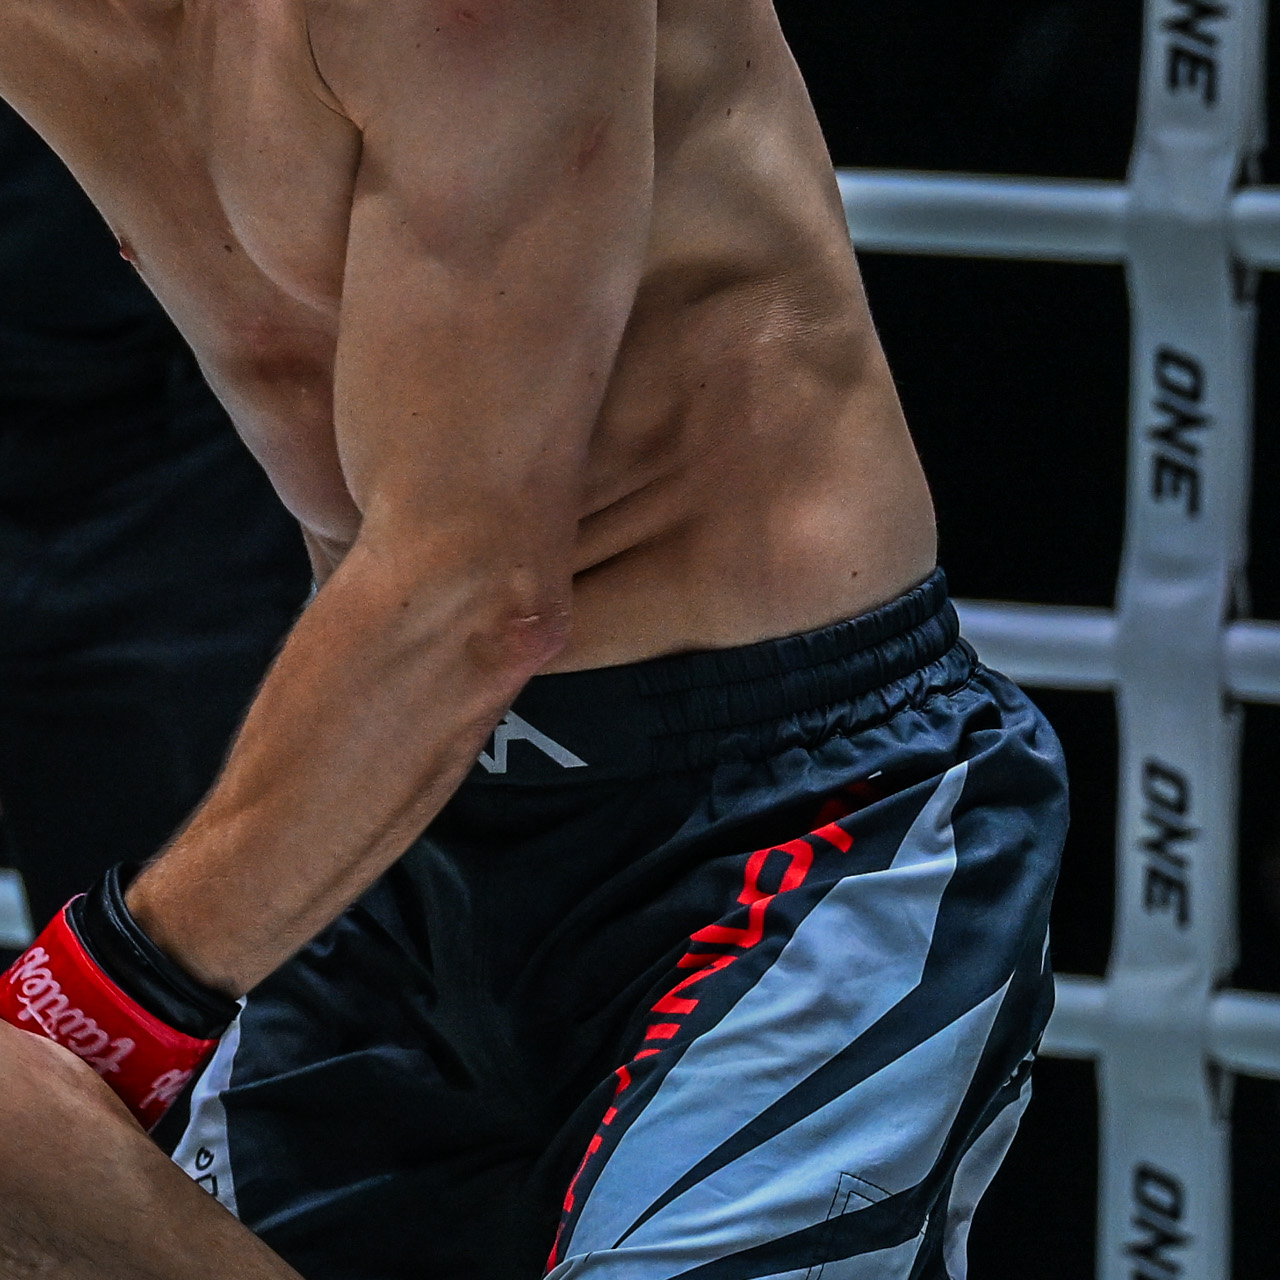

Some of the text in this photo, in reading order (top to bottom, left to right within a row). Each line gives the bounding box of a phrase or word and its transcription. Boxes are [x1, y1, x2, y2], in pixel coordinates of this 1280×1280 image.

[1146, 344, 1213, 520] ONE
[1137, 758, 1200, 930] ONE
[1123, 1160, 1194, 1280] ON
